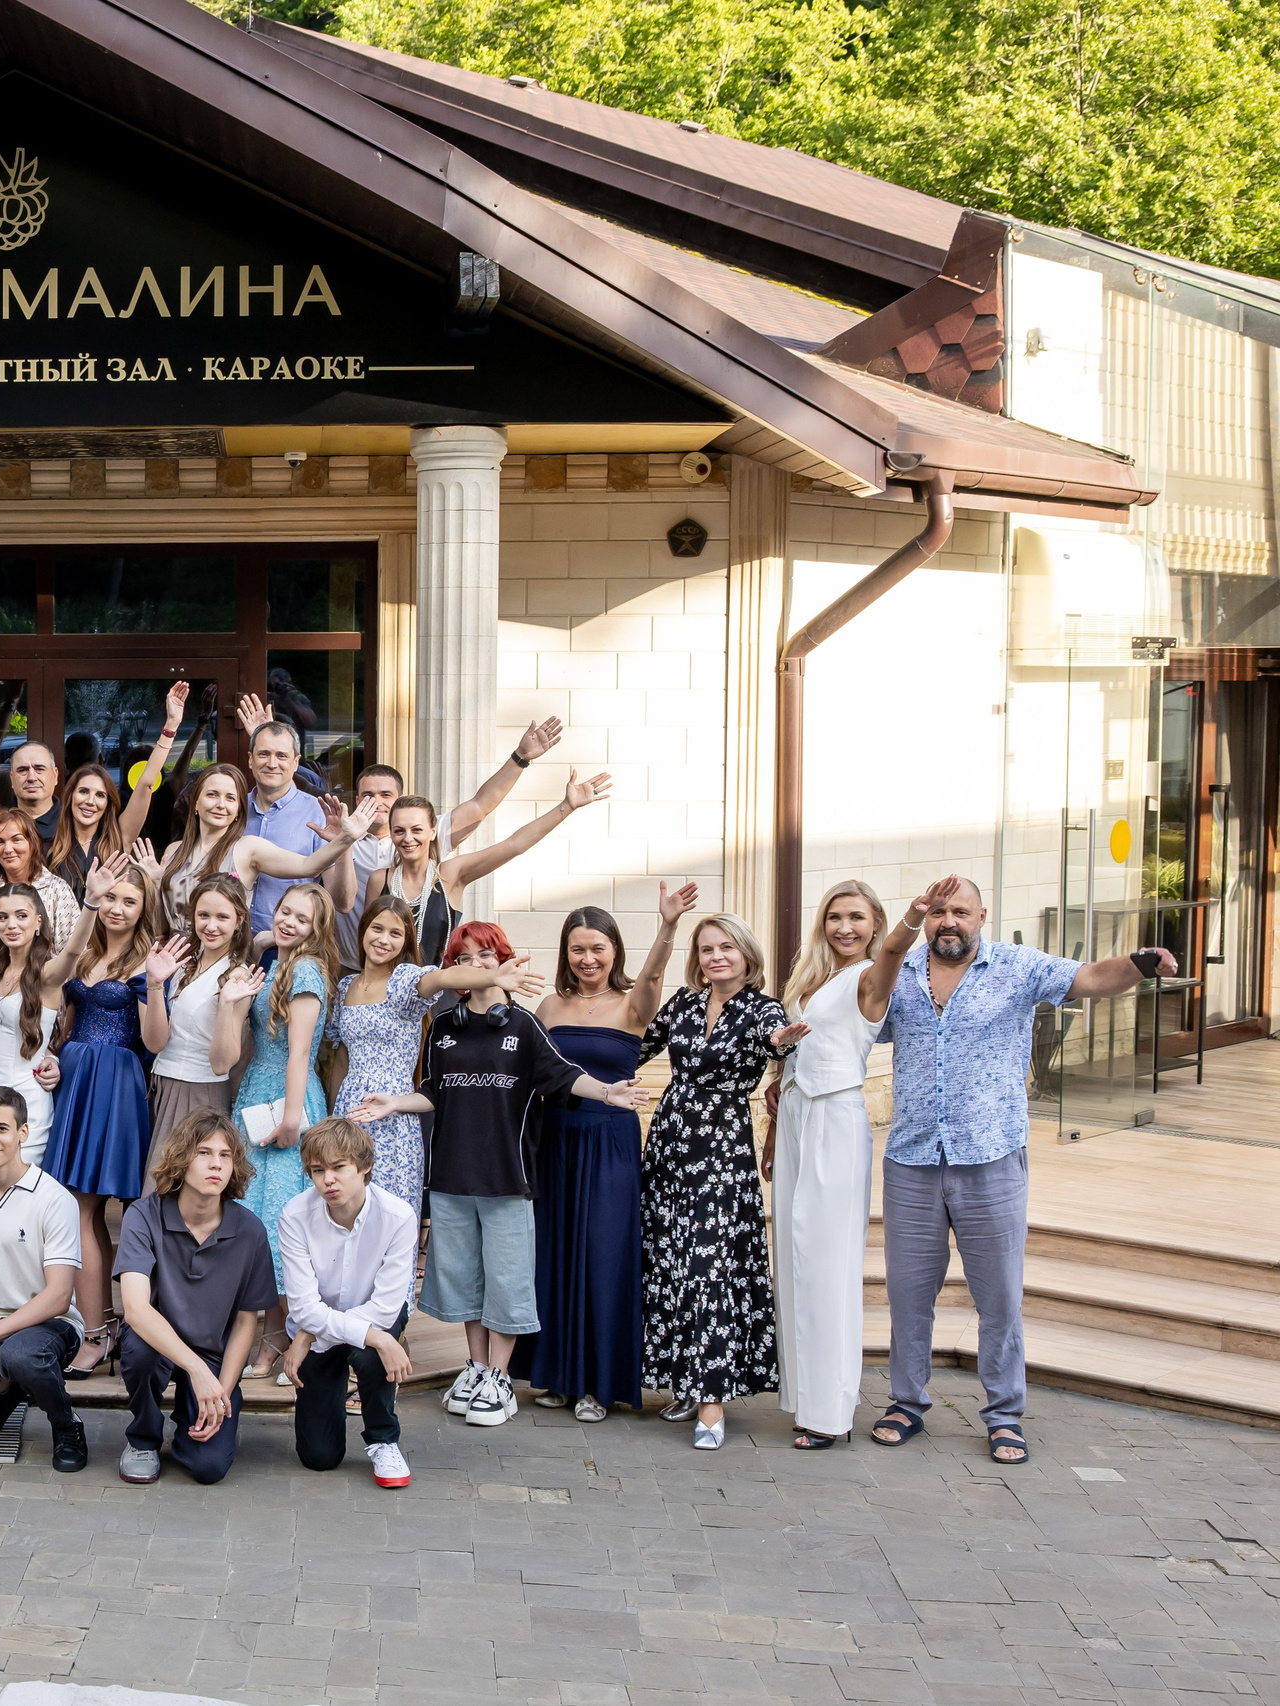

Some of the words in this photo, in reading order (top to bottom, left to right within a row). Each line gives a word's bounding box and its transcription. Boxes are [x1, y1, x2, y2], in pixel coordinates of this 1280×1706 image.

[3, 265, 342, 320] МАЛИНА
[107, 358, 177, 382] ЗАЛ
[203, 356, 365, 381] КАРАОКЕ
[439, 1073, 519, 1089] TRANGE
